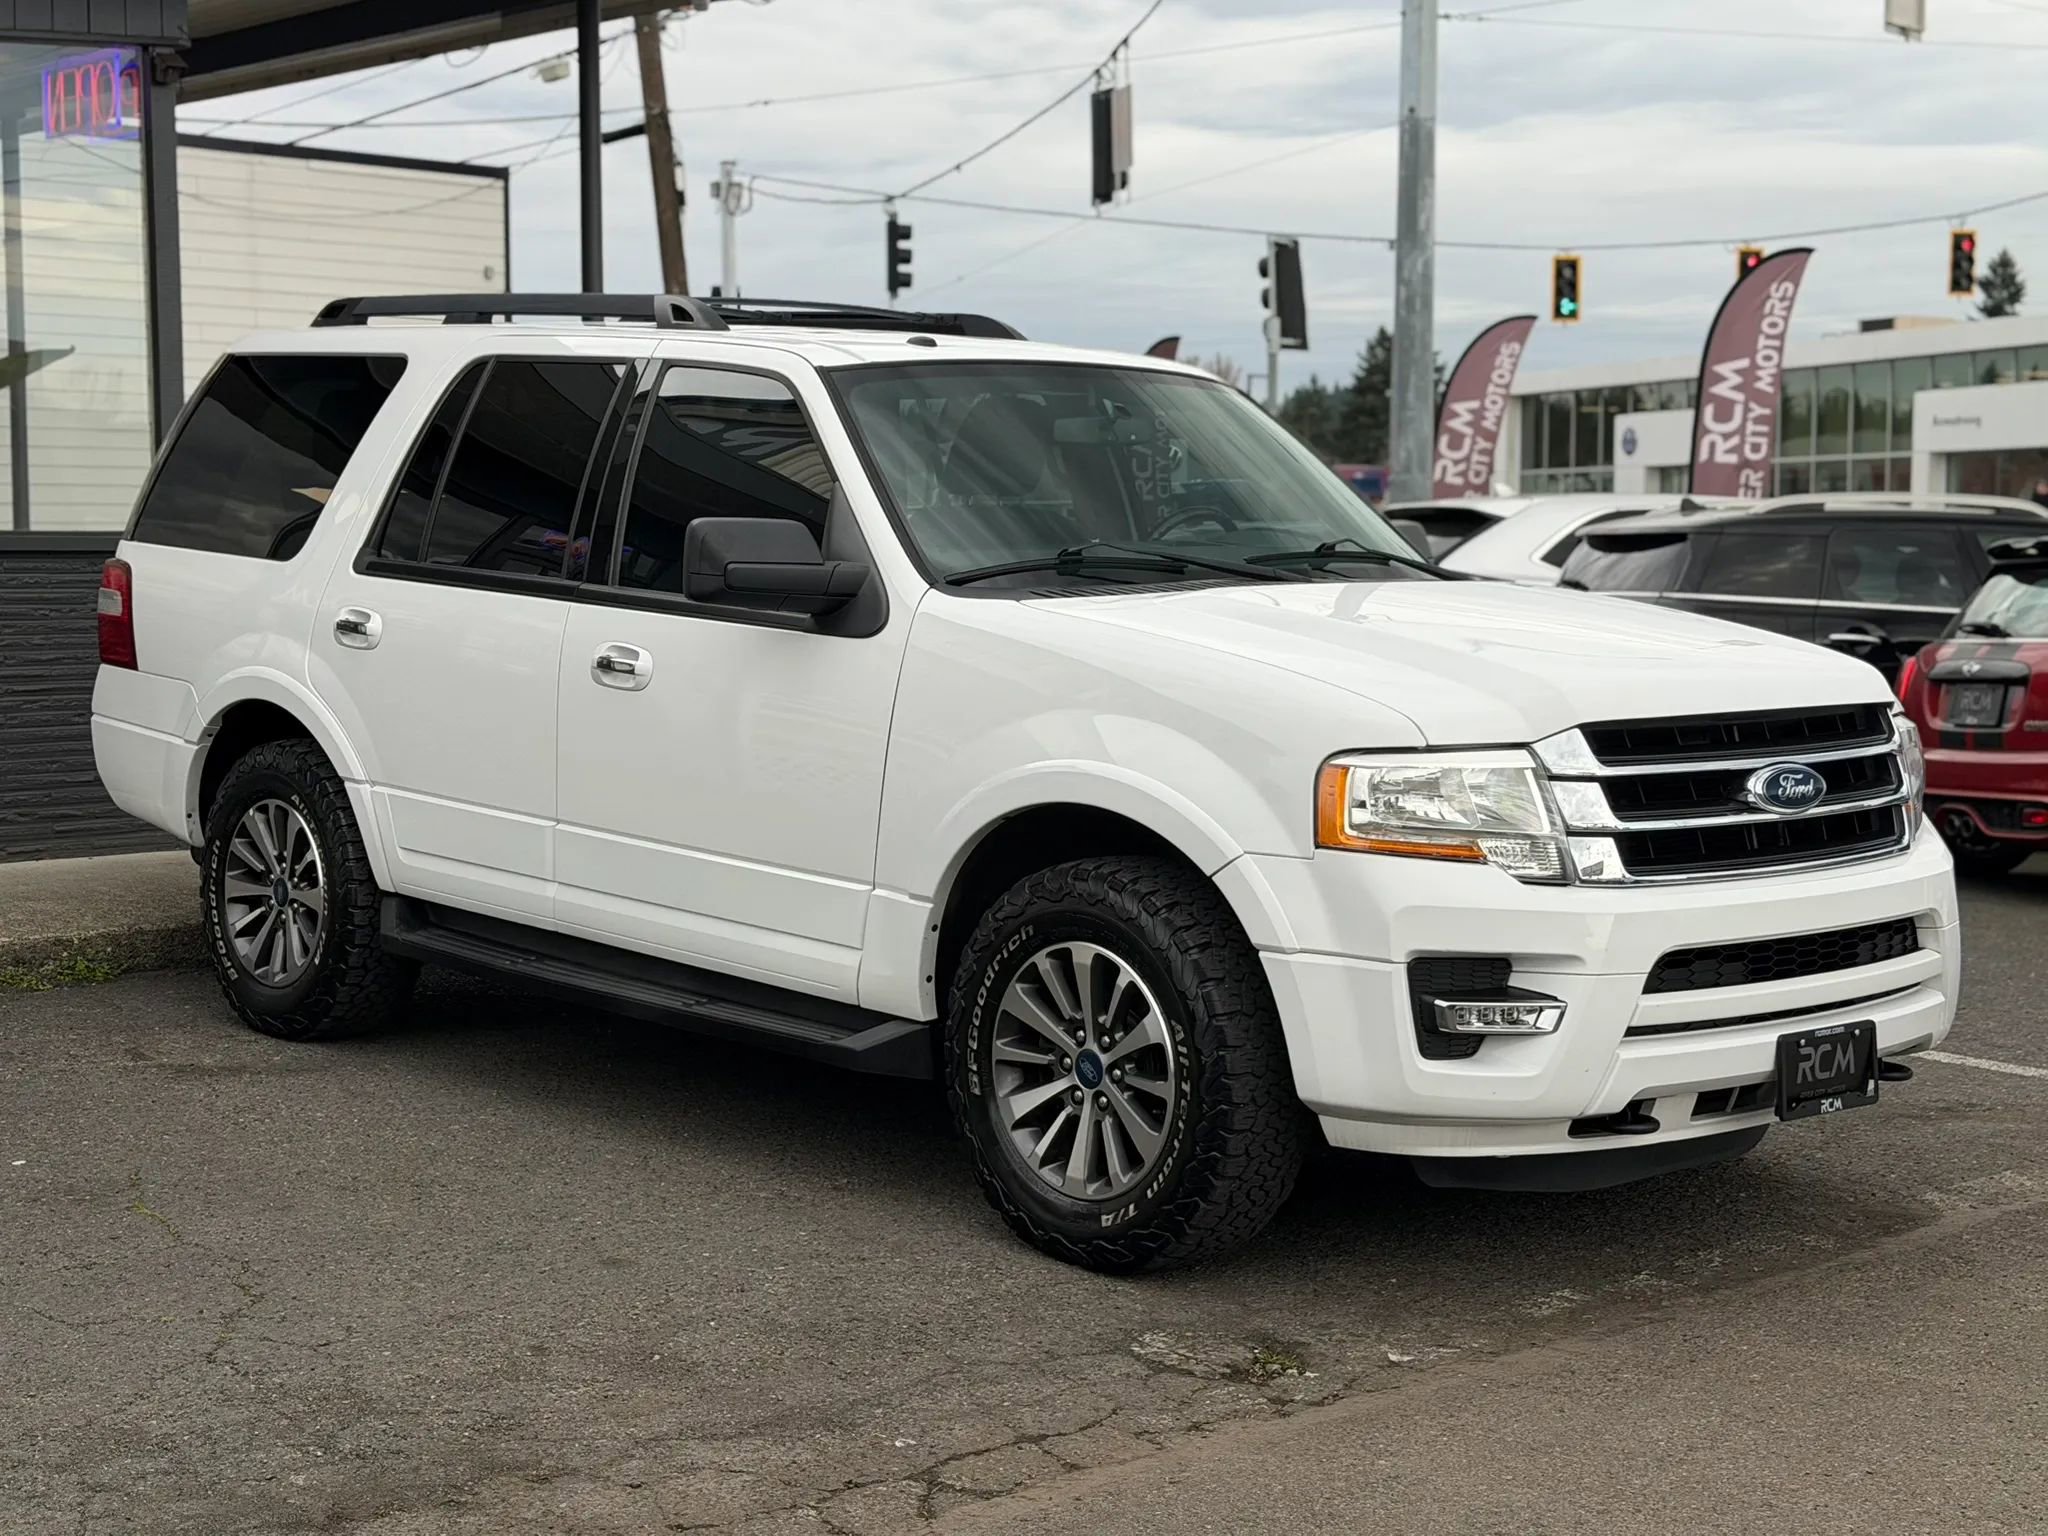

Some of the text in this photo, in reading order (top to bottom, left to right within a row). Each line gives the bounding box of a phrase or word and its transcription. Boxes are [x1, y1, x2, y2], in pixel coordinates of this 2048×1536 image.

[1752, 280, 1795, 394] MOTORS
[1480, 341, 1521, 432] MOTORS
[1699, 357, 1750, 465] RCM
[1433, 399, 1481, 486] RCM
[1467, 436, 1494, 485] CITY
[1743, 401, 1773, 461] CITY
[1778, 773, 1815, 800] Ford
[209, 839, 239, 980] BFGoodrich
[967, 924, 1034, 1095] BFGoodrich
[1797, 1040, 1855, 1084] RCM
[1821, 1097, 1843, 1113] RCM
[1101, 1202, 1138, 1228] T/A
